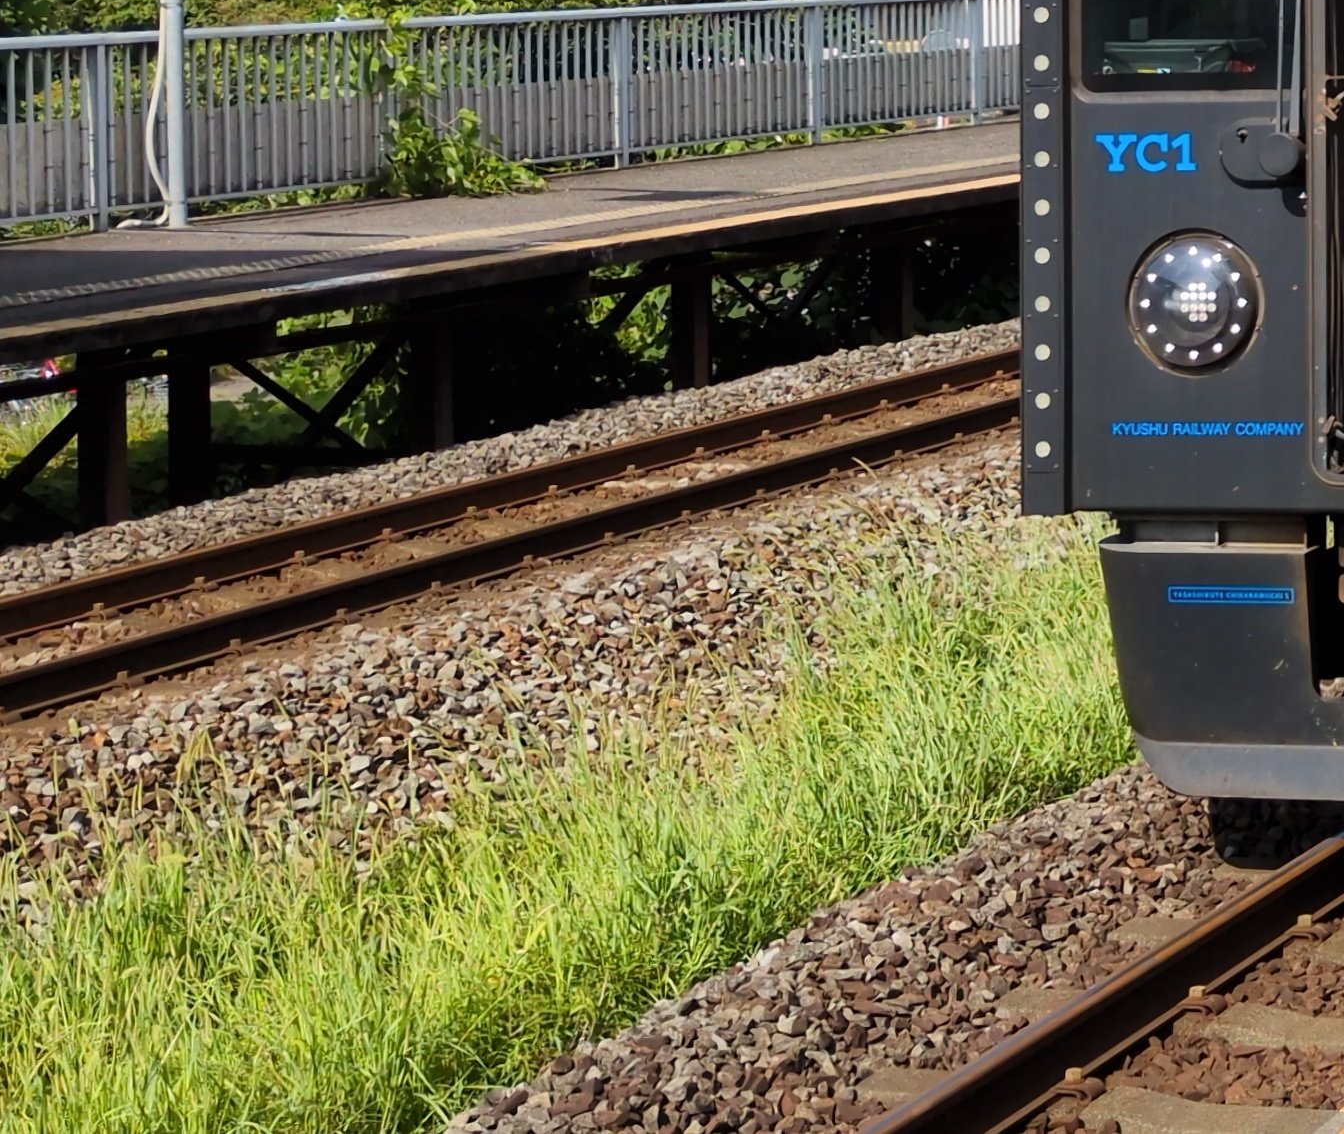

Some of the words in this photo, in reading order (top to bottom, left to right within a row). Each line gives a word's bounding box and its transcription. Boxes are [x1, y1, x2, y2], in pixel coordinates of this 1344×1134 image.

[1095, 133, 1198, 172] YC1
[1112, 422, 1169, 436] KYUSHU
[1173, 422, 1232, 436] RAILWAY
[1235, 422, 1304, 436] COMPANY
